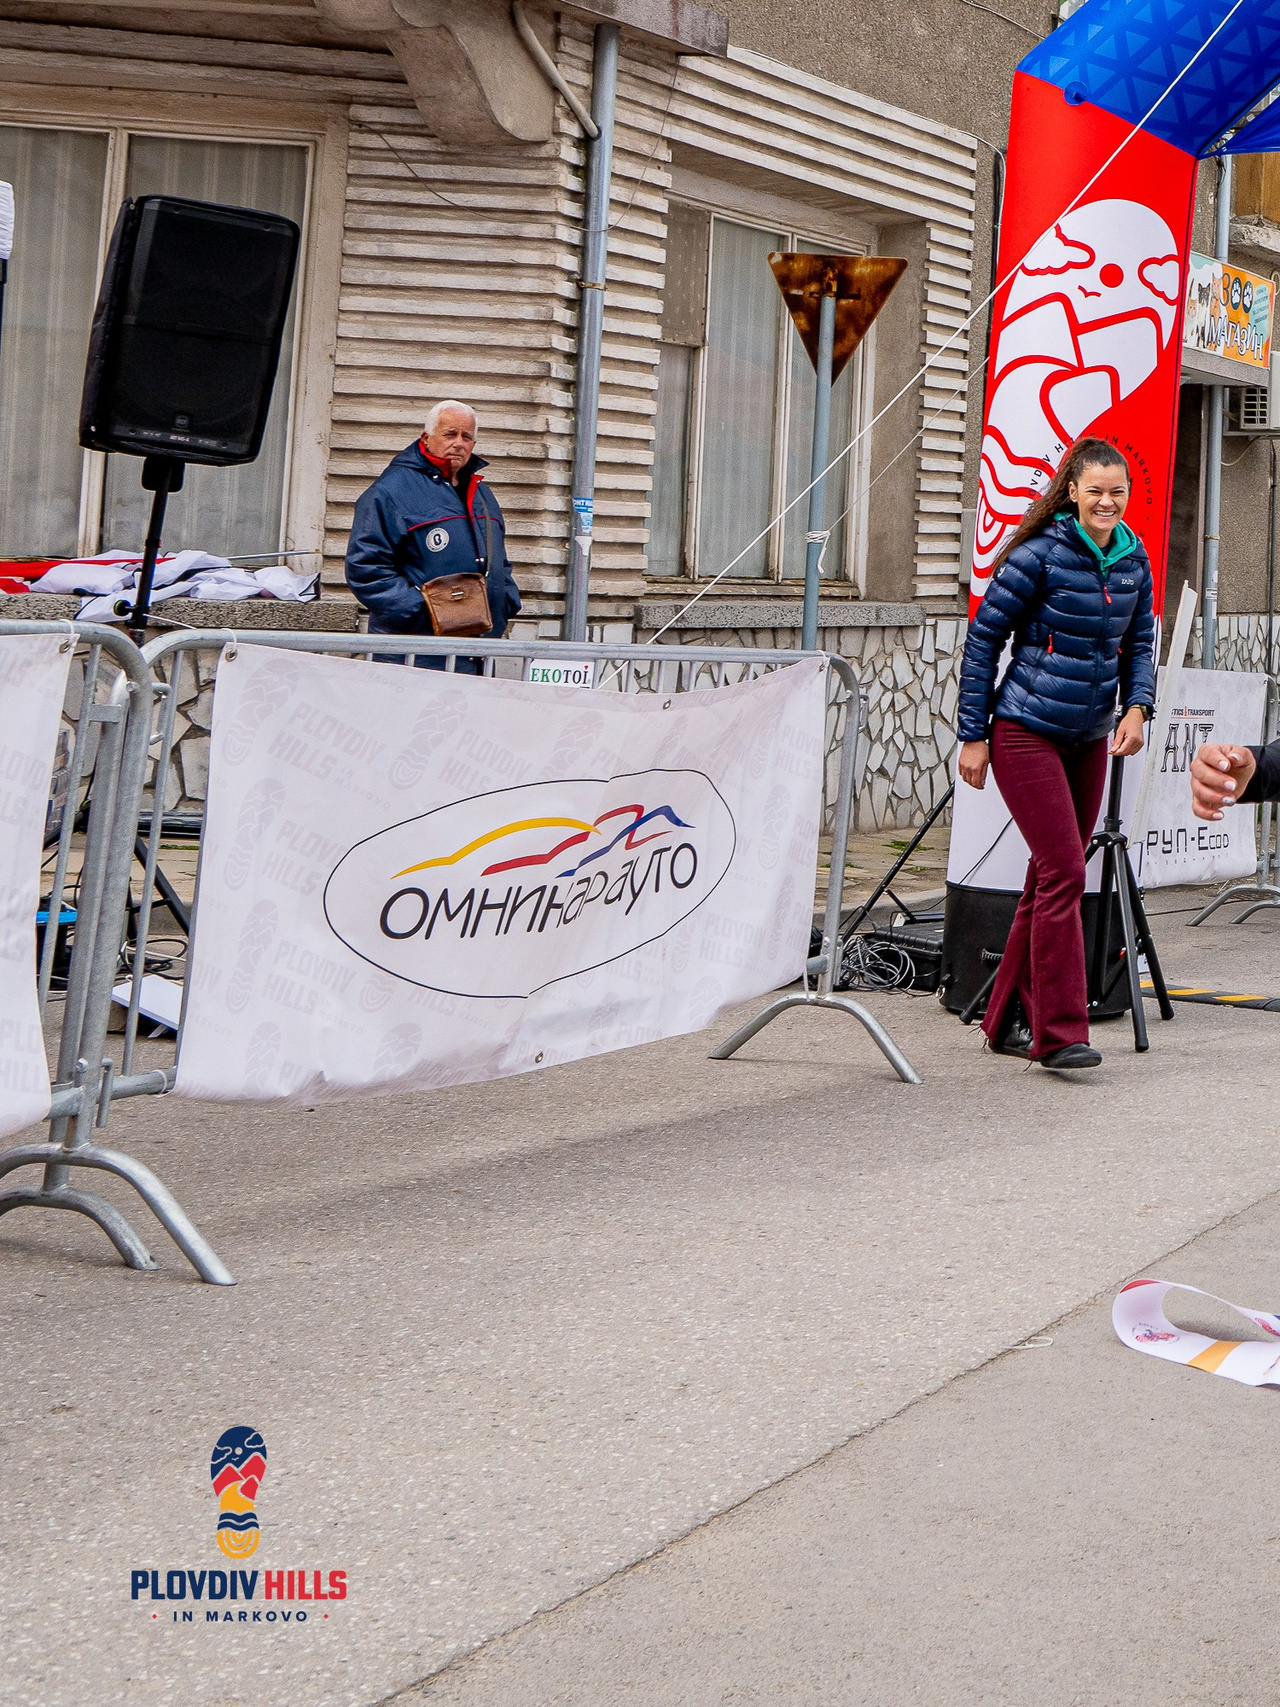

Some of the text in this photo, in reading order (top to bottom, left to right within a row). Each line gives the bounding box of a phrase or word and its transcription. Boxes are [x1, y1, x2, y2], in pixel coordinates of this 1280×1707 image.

[1209, 315, 1263, 360] МАГАЗИН
[267, 730, 338, 780] HILLS
[287, 702, 387, 765] PLOVDIV
